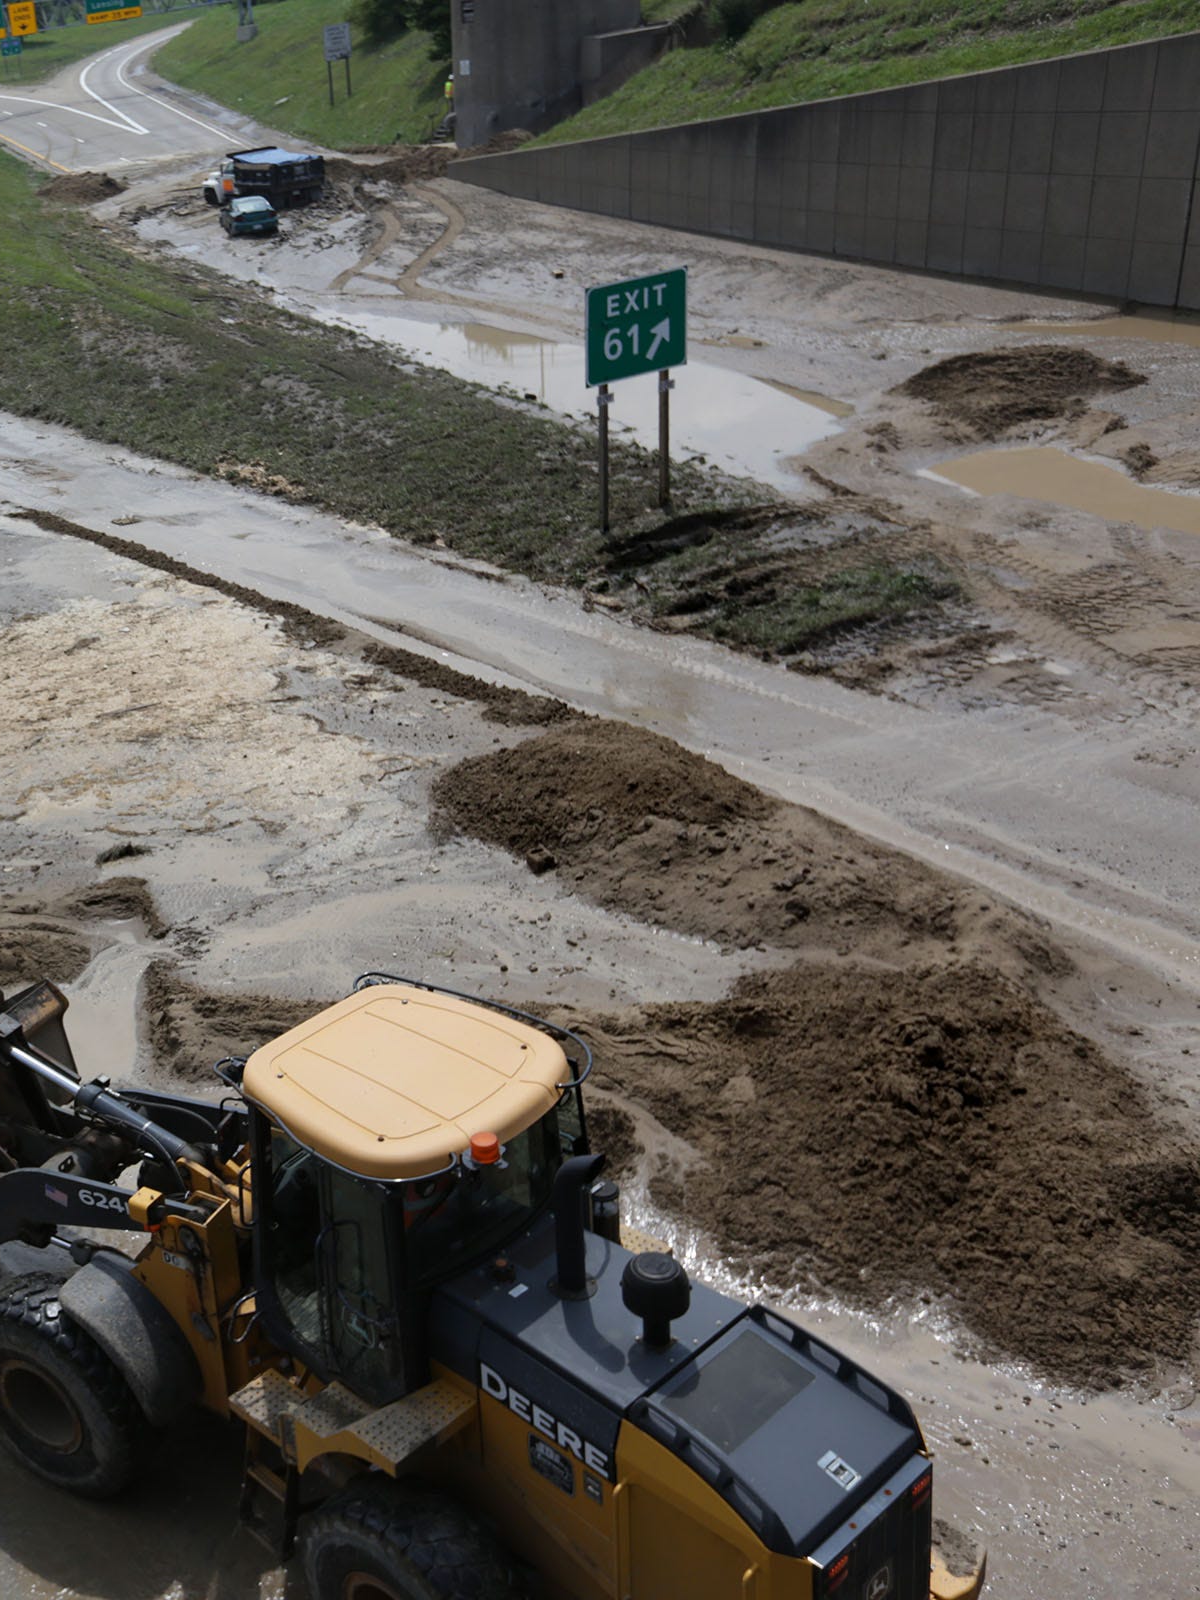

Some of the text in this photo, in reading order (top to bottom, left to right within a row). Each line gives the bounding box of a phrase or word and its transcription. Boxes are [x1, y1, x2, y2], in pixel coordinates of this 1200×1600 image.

[607, 283, 667, 318] EXIT
[603, 323, 640, 361] 61
[78, 1189, 130, 1215] 624
[480, 1362, 609, 1479] DEERE
